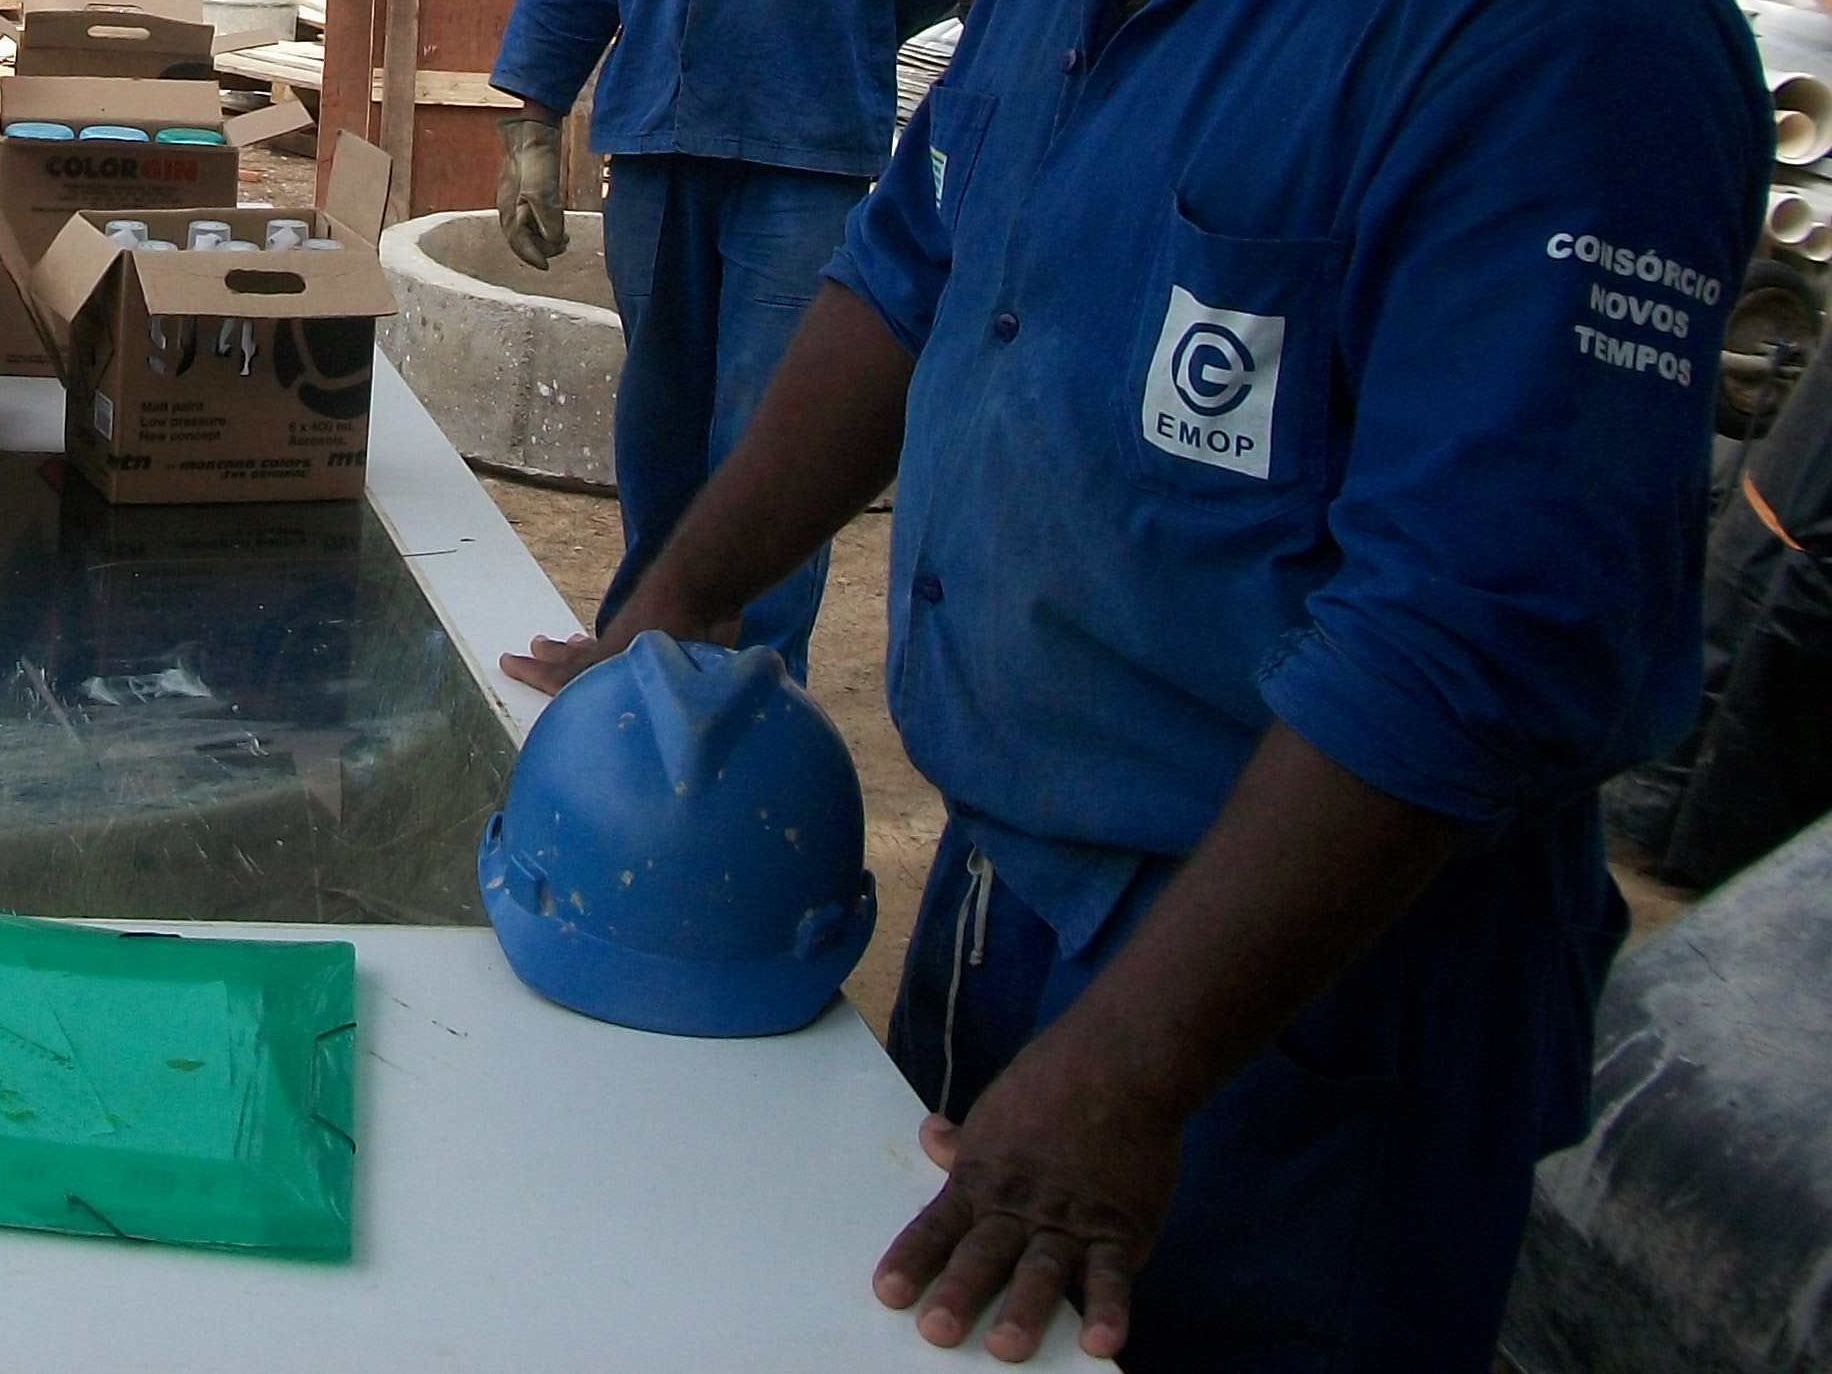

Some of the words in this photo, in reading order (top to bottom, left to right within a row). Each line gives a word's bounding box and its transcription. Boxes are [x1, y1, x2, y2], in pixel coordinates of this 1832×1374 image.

[45, 155, 198, 180] COLORGIN
[1546, 232, 1721, 306] CONSÓRCIO
[1590, 282, 1690, 339] NOVOS
[1574, 324, 1692, 387] TEMPOS
[1157, 412, 1255, 457] EMOP
